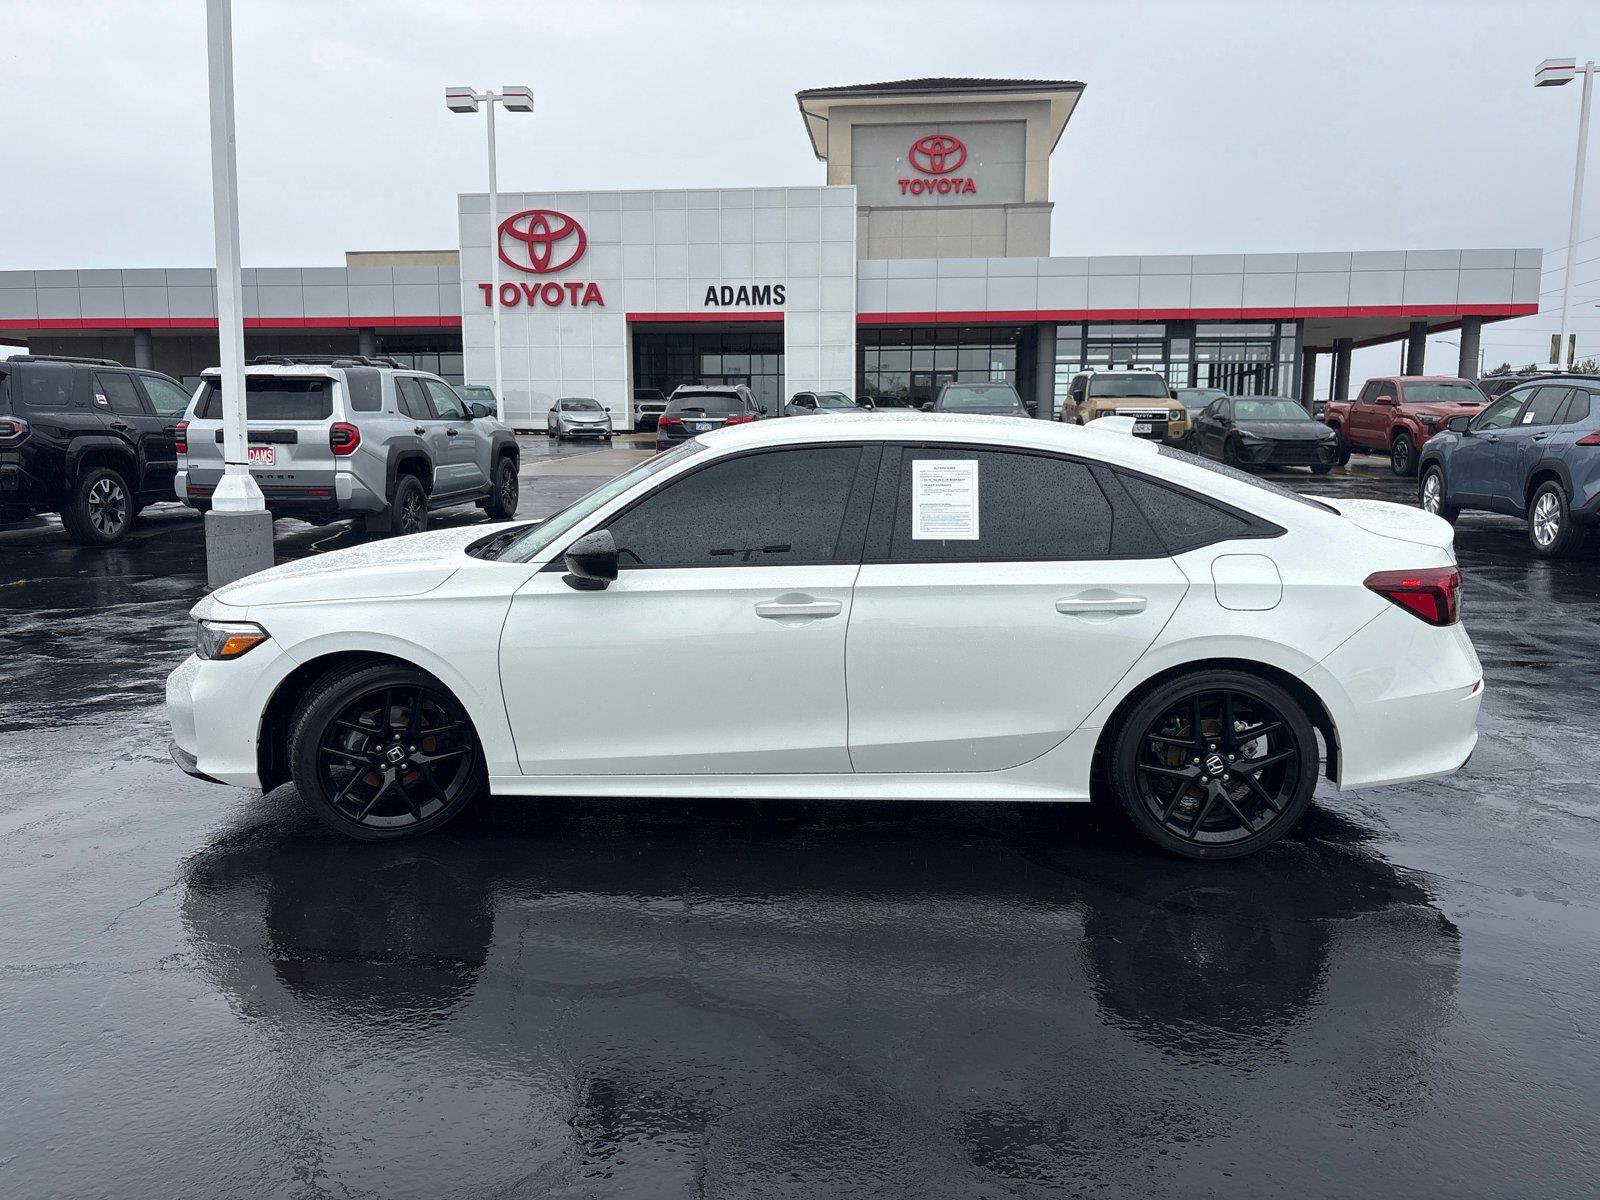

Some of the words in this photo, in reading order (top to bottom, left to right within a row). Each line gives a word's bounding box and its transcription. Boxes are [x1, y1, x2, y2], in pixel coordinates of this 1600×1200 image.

[898, 179, 976, 195] TOYOTA
[478, 282, 605, 307] TOYOTA
[704, 285, 786, 306] ADAMS
[249, 449, 273, 462] DAMS
